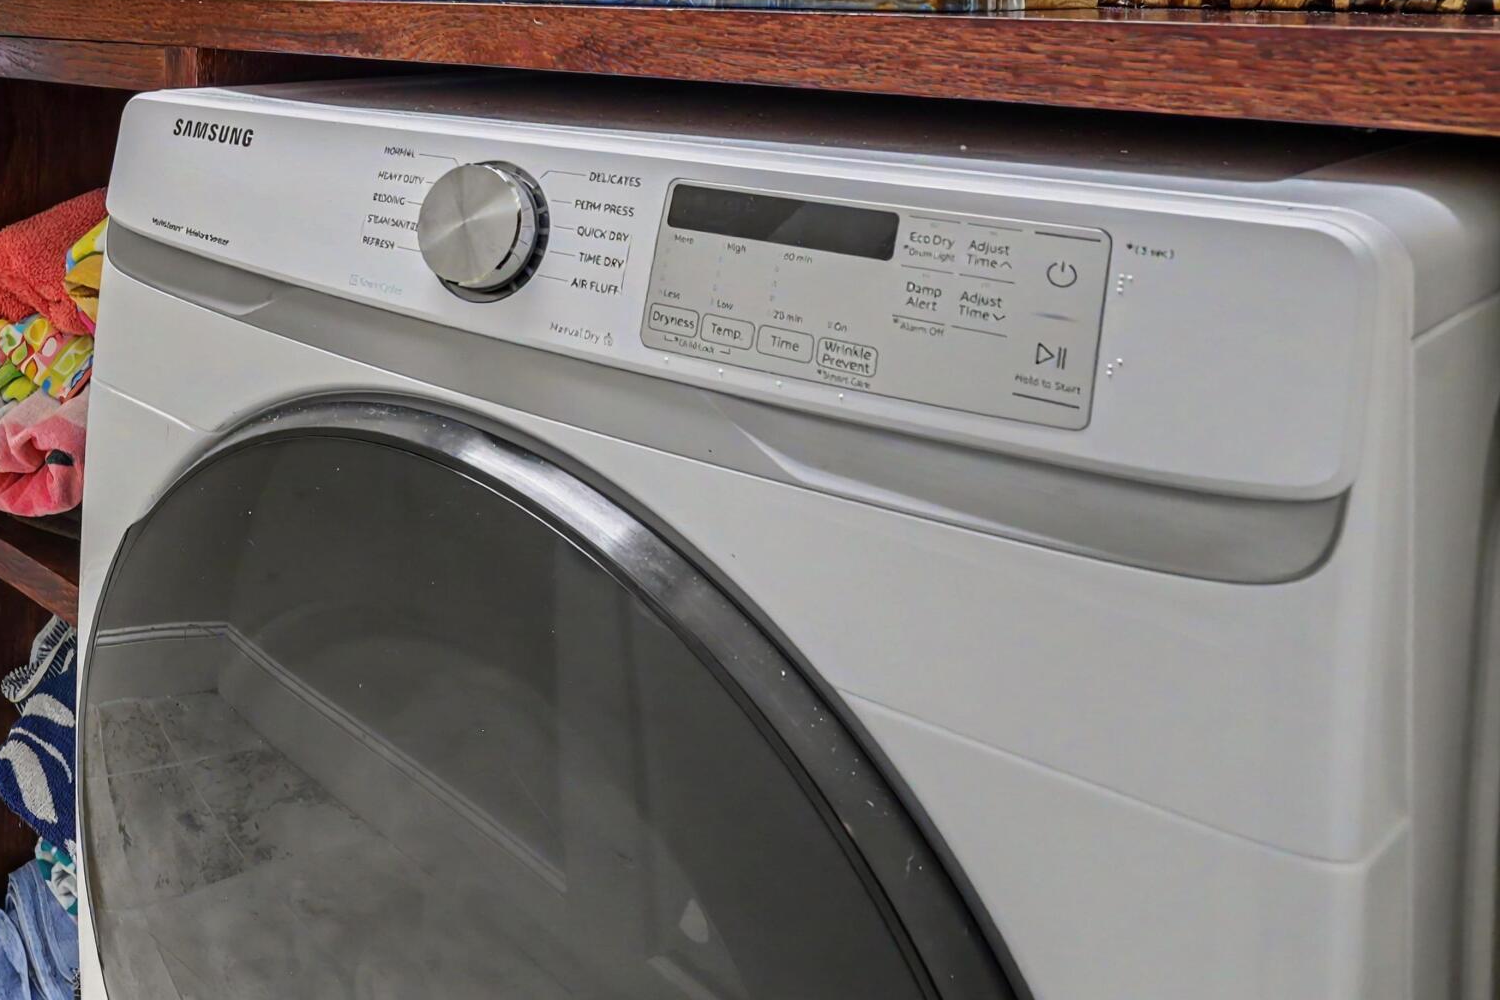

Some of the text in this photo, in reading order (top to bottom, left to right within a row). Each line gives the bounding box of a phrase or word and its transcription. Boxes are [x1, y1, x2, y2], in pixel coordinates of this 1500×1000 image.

[173, 118, 254, 147] SAMSUNG
[403, 174, 425, 185] DUTY
[589, 171, 642, 188] DELICATES
[603, 203, 635, 218] PRESS
[577, 226, 630, 242] QUICK DRY
[909, 231, 955, 250] Eco Dry
[968, 239, 1010, 257] Adjust
[579, 251, 625, 269] TIME DRY
[966, 253, 998, 269] Time
[570, 277, 619, 295] AIR FLUFF
[905, 281, 942, 298] Damp
[716, 299, 734, 311] Low
[905, 296, 938, 311] Alert
[960, 291, 1002, 308] Adjust
[652, 310, 695, 329] Dryness
[959, 304, 990, 321] Time
[833, 322, 848, 332] On
[584, 329, 601, 345] Dry
[771, 334, 800, 352] Time
[824, 340, 872, 361] Wrinkle
[821, 353, 870, 374] Prevent
[1041, 379, 1052, 389] to
[1054, 382, 1082, 395] Start
